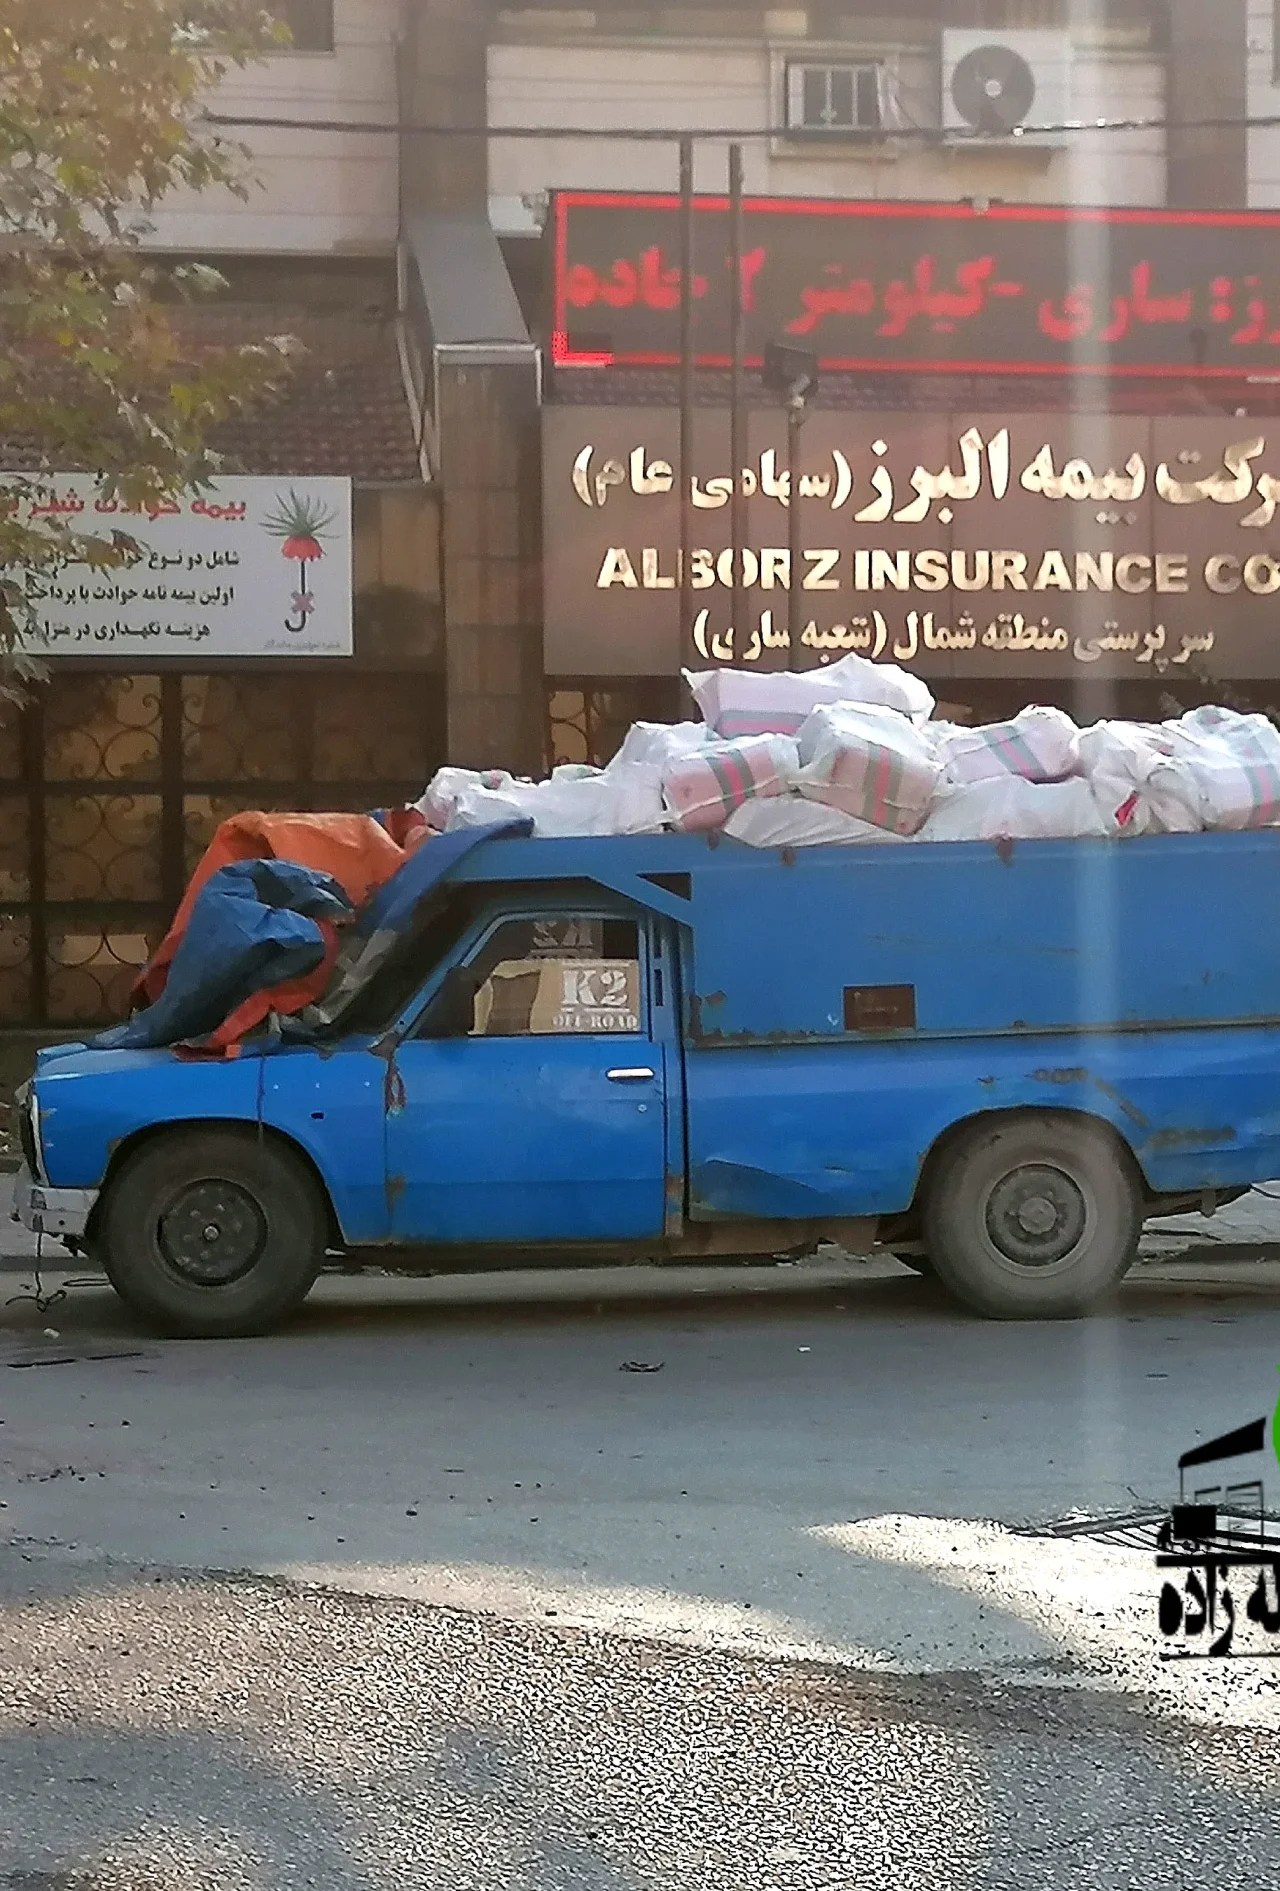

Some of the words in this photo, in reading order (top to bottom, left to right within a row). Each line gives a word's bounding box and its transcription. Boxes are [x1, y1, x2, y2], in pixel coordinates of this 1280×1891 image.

[1038, 259, 1192, 341] ساری
[572, 445, 674, 507] عام)
[854, 427, 1009, 522] البرز
[1020, 443, 1147, 524] بیمه
[190, 498, 246, 521] بیمه
[597, 547, 841, 590] ALBORZ
[854, 550, 1190, 593] INSURANCE
[893, 609, 977, 661] شمال
[981, 612, 1069, 651] منطقه
[562, 969, 628, 1006] K2
